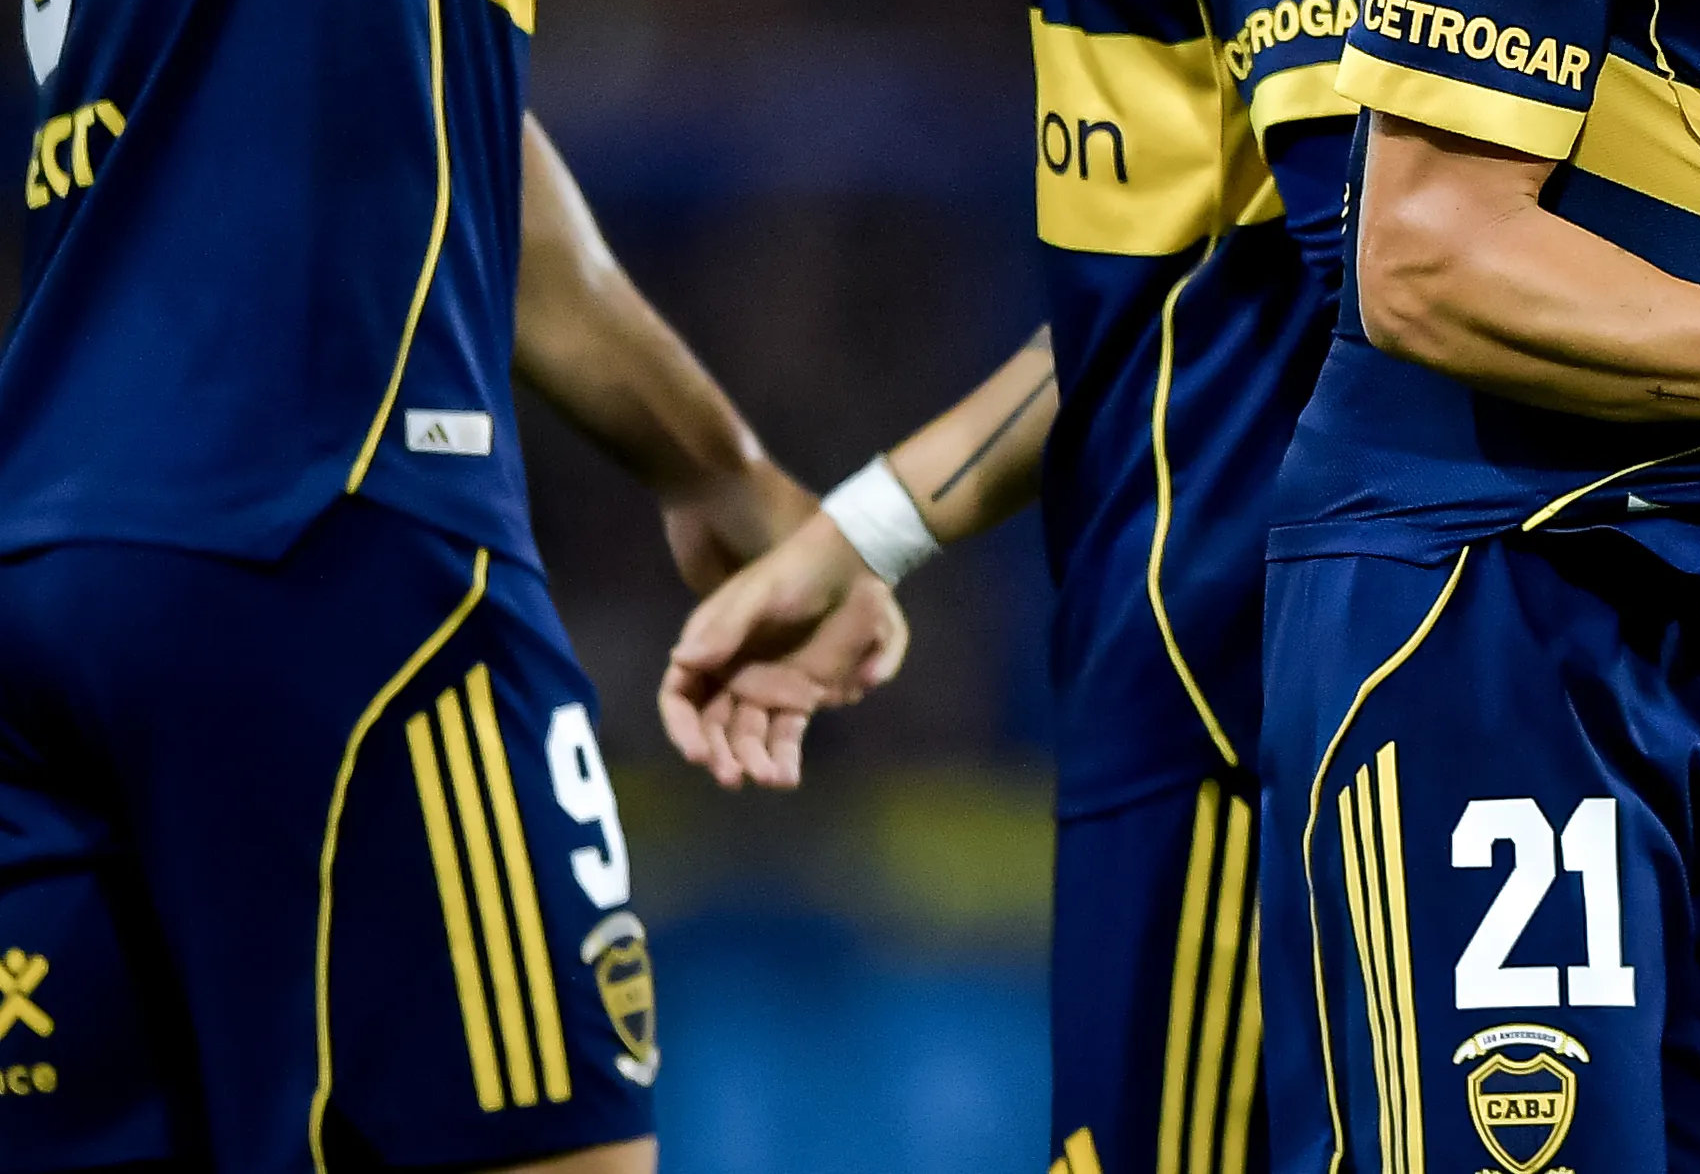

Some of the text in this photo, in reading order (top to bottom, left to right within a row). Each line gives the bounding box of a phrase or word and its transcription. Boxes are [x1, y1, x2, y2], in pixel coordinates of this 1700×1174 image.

[1042, 110, 1128, 184] on
[547, 702, 630, 909] 9
[1451, 797, 1636, 1010] 21
[1487, 1099, 1556, 1119] CABJ
